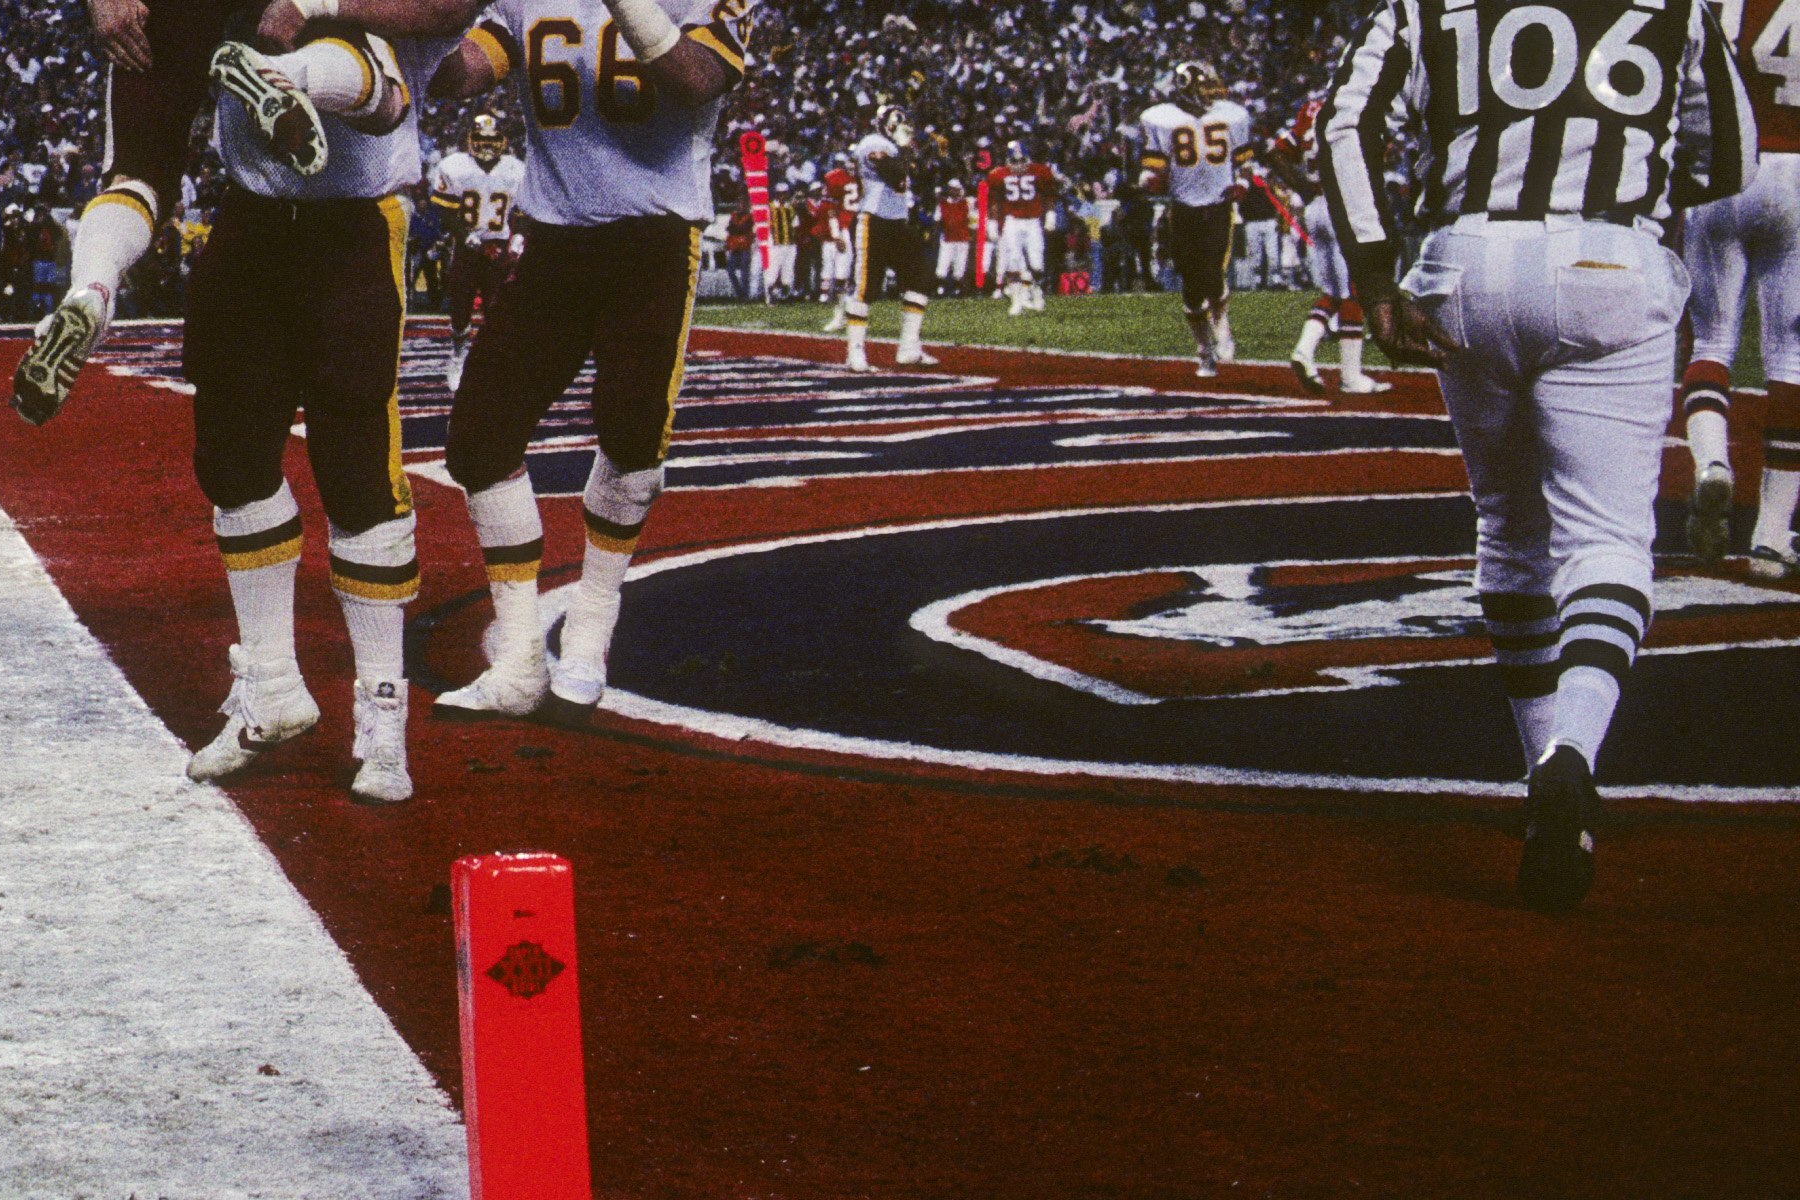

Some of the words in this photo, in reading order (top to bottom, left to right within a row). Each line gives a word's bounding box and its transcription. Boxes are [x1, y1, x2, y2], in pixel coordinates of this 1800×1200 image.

[525, 17, 656, 130] 66
[1440, 5, 1663, 116] 106
[1171, 122, 1230, 167] 85
[461, 188, 508, 232] 83
[1004, 175, 1036, 201] 55
